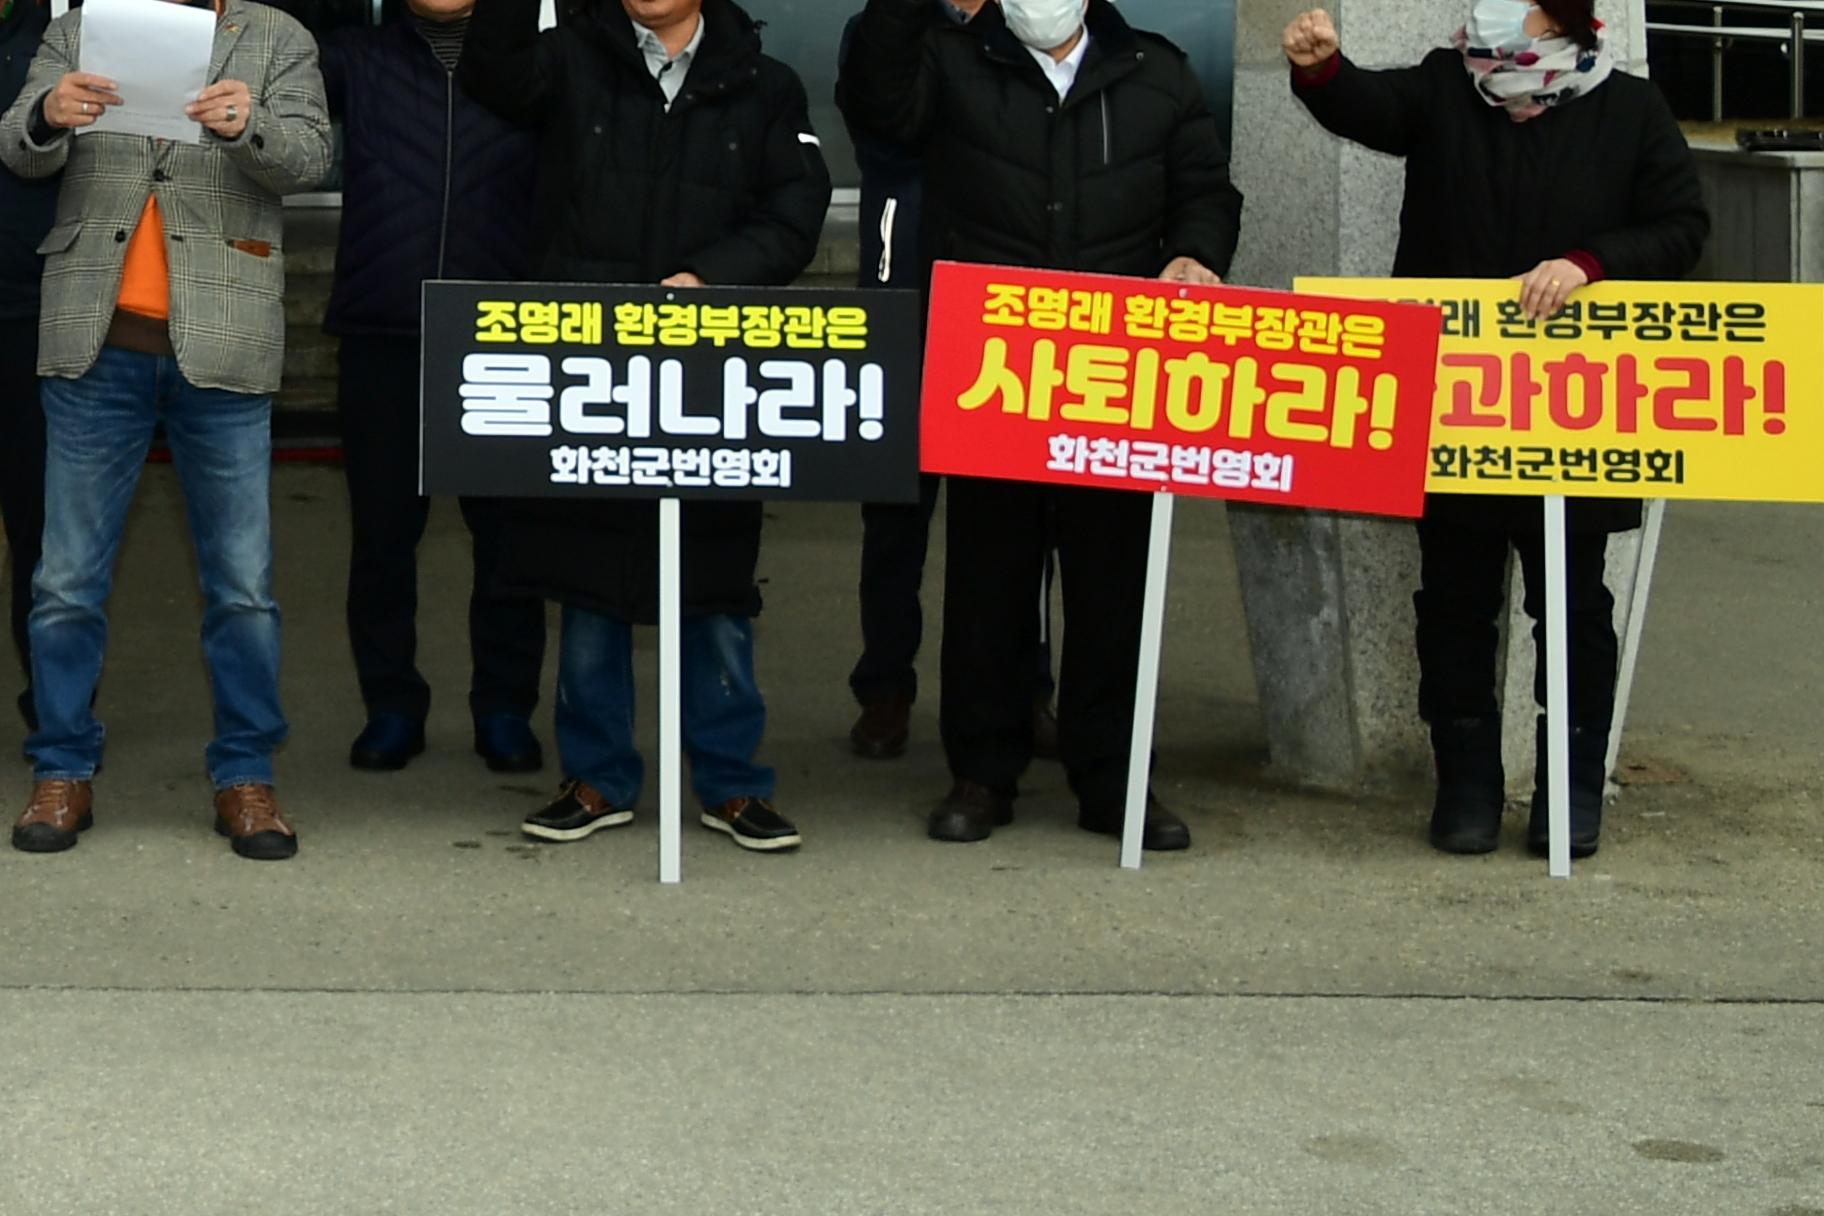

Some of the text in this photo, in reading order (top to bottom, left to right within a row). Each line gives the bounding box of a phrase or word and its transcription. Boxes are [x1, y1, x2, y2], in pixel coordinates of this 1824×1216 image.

[476, 301, 869, 350] 조명래 환경부장관은
[982, 284, 1114, 334] 조명래
[1124, 294, 1386, 360] 환경부장관은
[458, 352, 885, 442] 물러나라!
[957, 336, 1398, 451] 사퇴하라!
[1433, 352, 1786, 436] 과하라!
[549, 444, 792, 489] 화천군번영회
[1046, 434, 1294, 493] 화천군번영회
[1431, 444, 1685, 485] 화천군번영회
